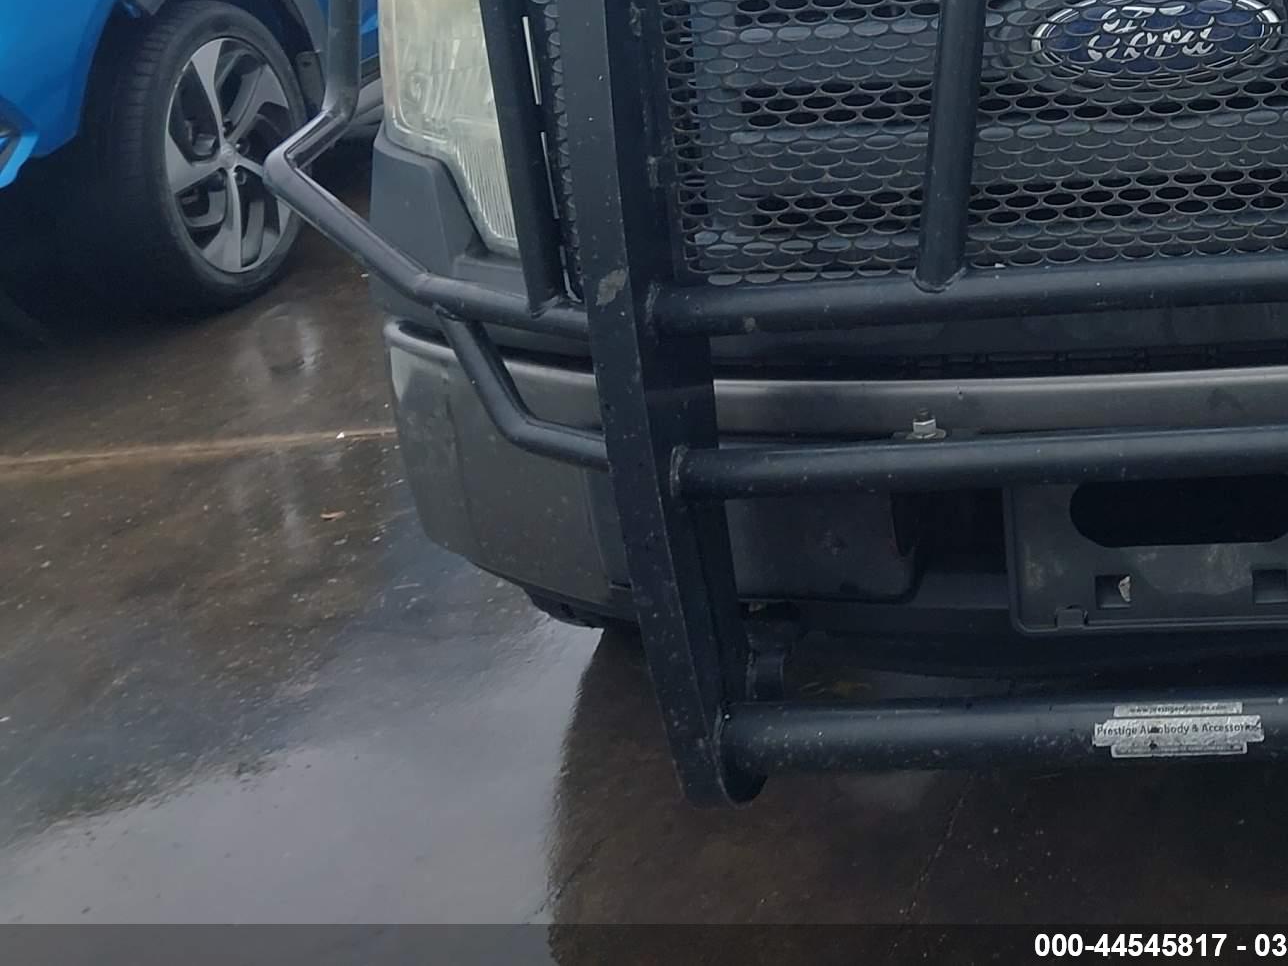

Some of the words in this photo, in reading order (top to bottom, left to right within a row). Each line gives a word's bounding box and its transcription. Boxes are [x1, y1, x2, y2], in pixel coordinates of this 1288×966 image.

[1088, 5, 1215, 60] Ford
[1097, 724, 1138, 736] Prestige
[1140, 723, 1190, 735] Auobody
[1192, 724, 1198, 733] &
